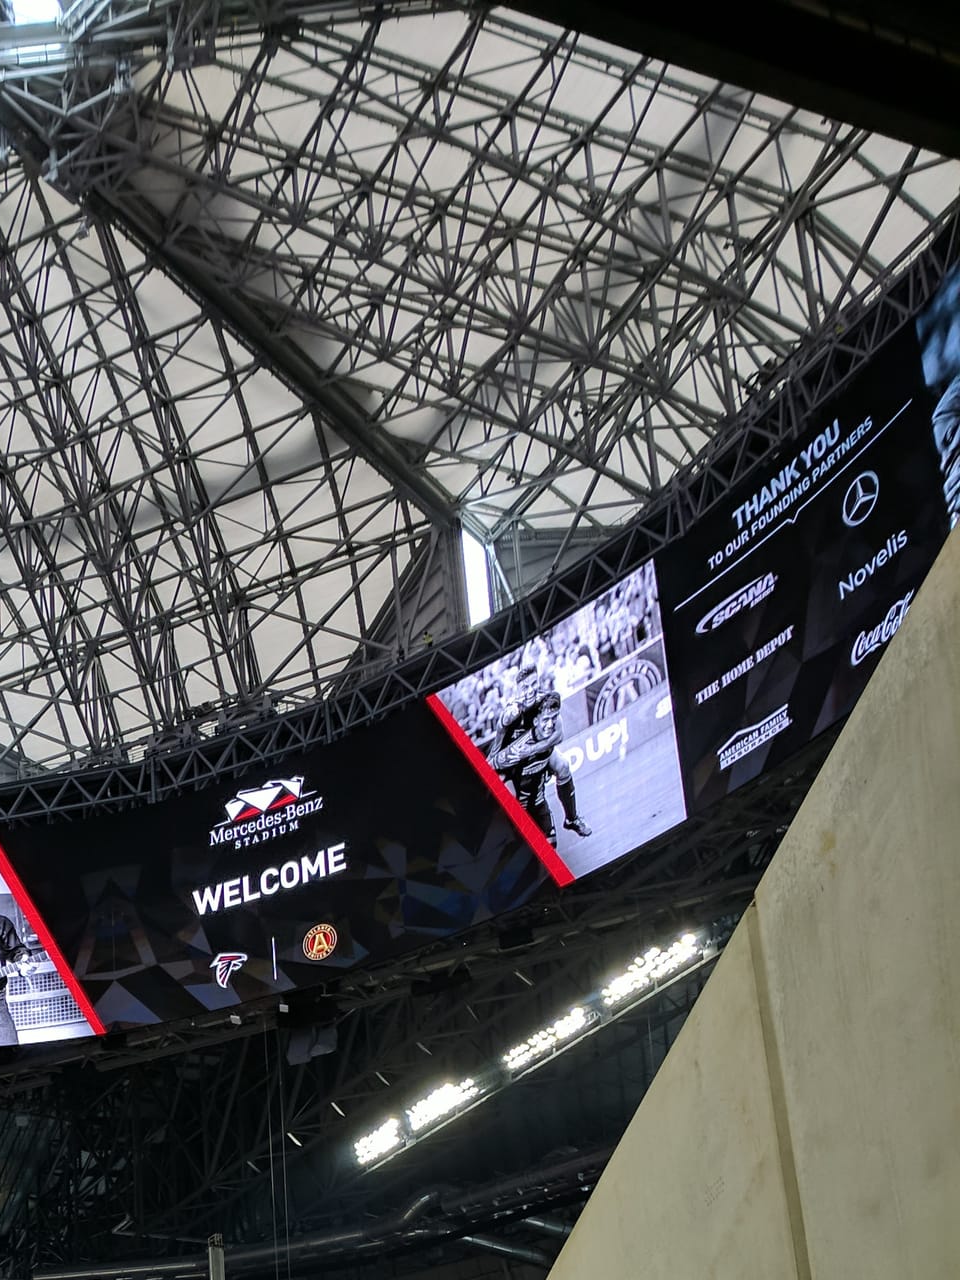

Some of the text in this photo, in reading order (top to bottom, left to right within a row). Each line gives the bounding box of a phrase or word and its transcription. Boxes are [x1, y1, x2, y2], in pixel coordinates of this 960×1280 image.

[707, 415, 873, 570] TO OUR FOUNDING PARTNERS
[732, 418, 841, 530] THANK YOU
[839, 529, 908, 600] Novelis
[711, 571, 777, 630] SCANA
[695, 624, 795, 705] THE HOME DEPOT
[720, 709, 789, 762] AMERICAN FAMILY
[209, 797, 323, 846] Mercedes-Benz
[234, 820, 299, 850] STADIUM
[192, 842, 347, 916] WELCOME
